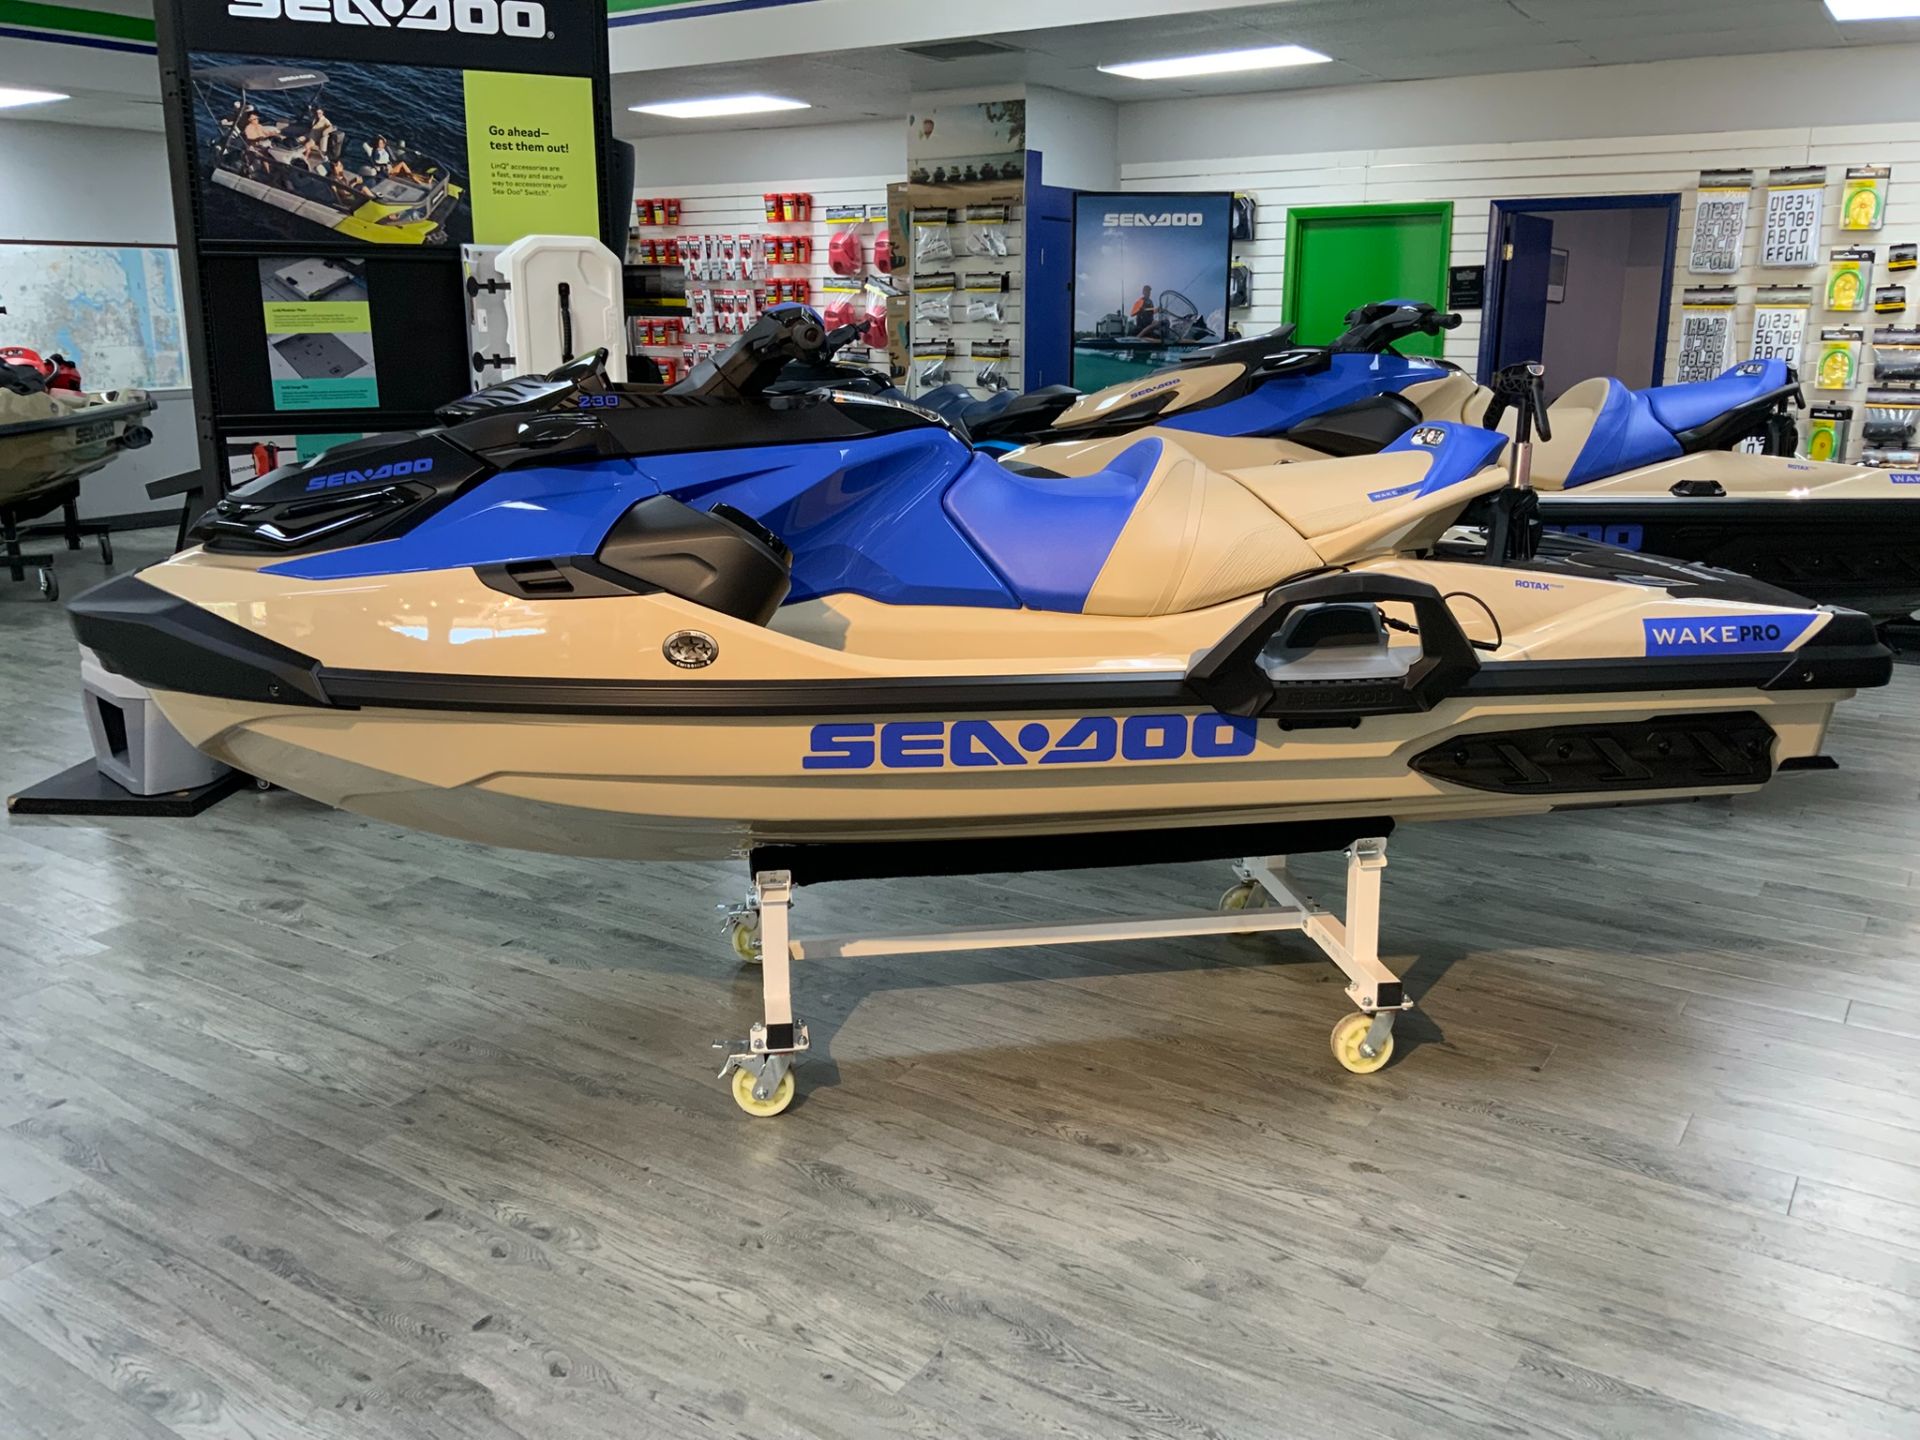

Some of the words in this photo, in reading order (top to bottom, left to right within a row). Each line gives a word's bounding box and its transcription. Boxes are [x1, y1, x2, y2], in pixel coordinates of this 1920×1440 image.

[489, 125, 505, 136] Go
[489, 141, 514, 151] test
[515, 141, 544, 152] them
[546, 143, 569, 154] out!
[511, 164, 548, 172] accessories
[578, 395, 620, 408] 230
[1515, 580, 1550, 591] ROTAX
